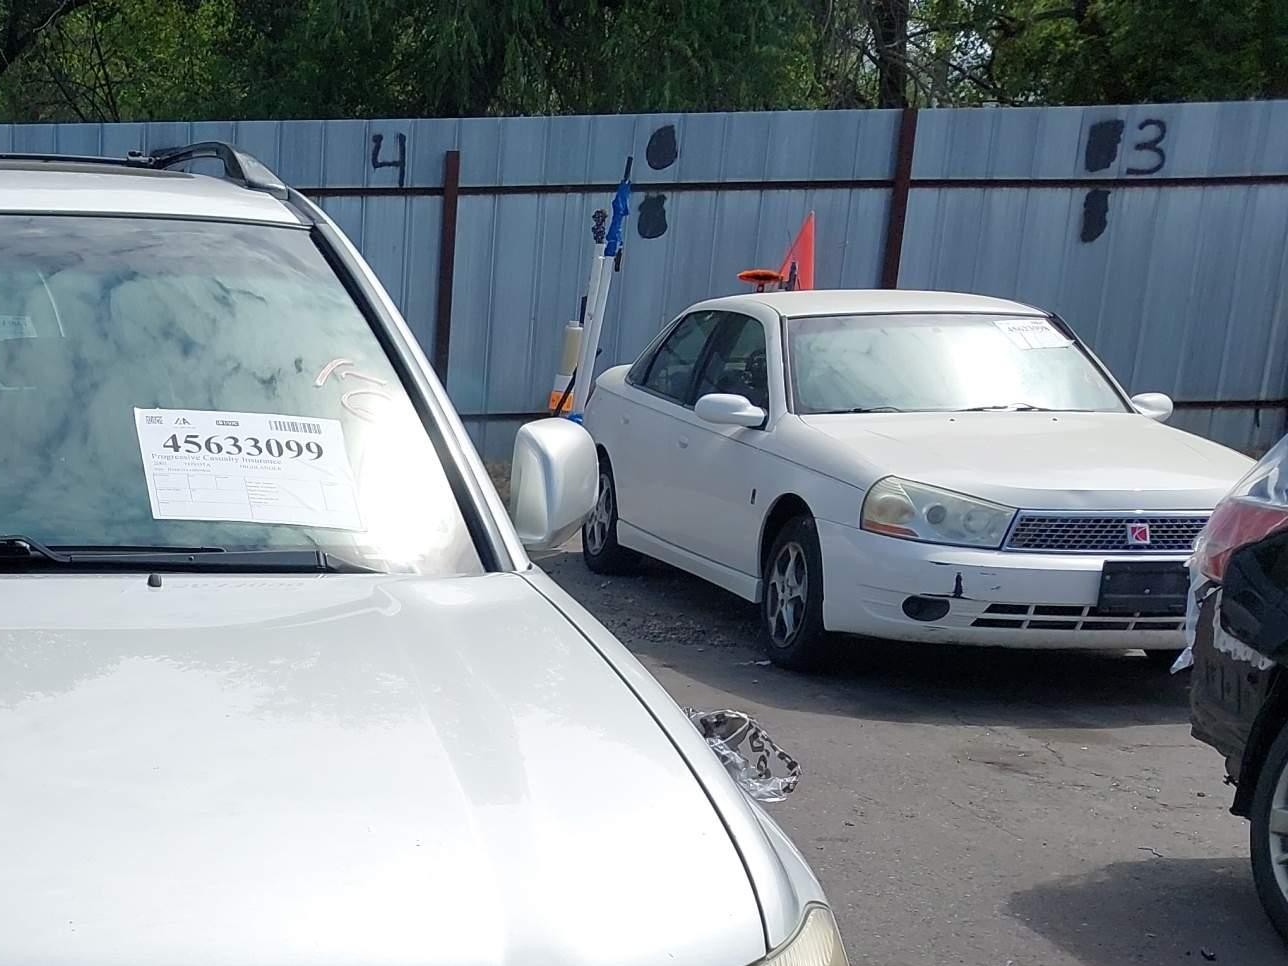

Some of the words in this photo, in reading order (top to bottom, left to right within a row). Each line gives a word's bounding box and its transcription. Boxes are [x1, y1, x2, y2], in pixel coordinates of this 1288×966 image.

[372, 132, 406, 188] 4
[1126, 119, 1166, 175] 3
[162, 433, 324, 461] 45633099
